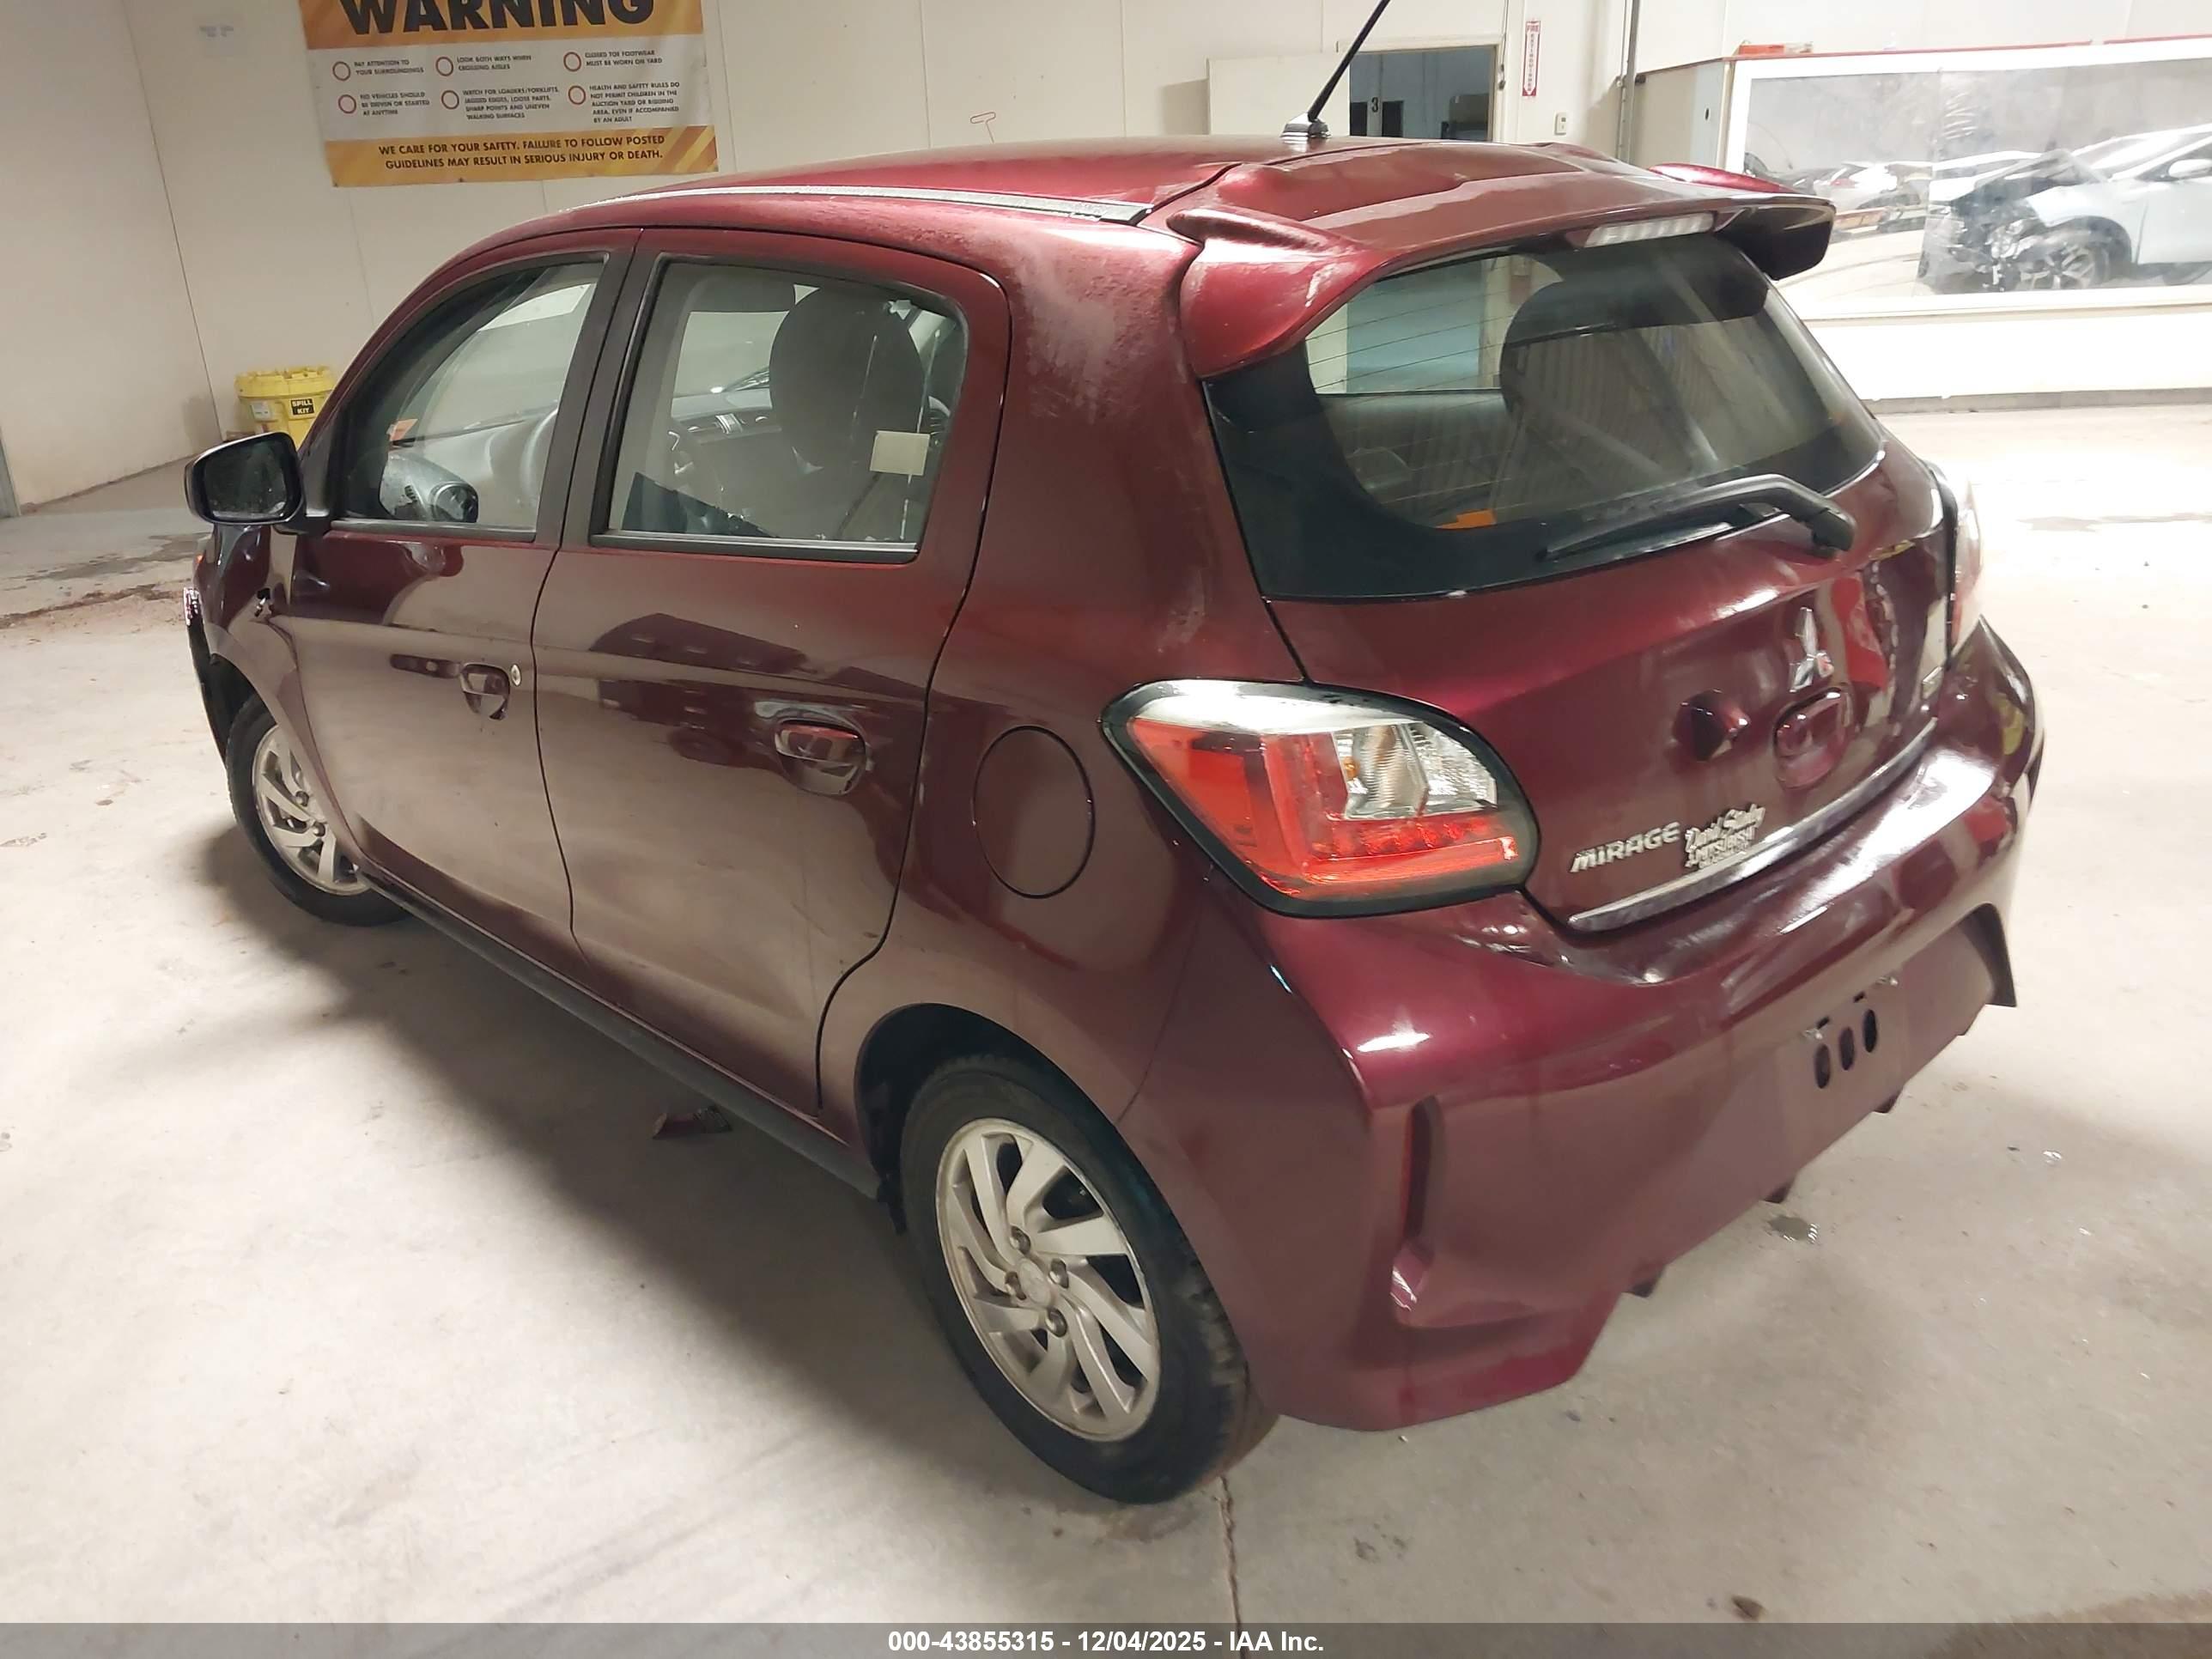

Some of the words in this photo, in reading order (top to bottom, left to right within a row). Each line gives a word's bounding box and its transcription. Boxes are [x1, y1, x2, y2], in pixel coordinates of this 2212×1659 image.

[340, 0, 654, 34] WARNING
[1371, 97, 1378, 112] 3
[379, 145, 396, 155] WE
[399, 144, 425, 154] CARE
[428, 143, 447, 153] FOR
[451, 142, 480, 152] YOUR
[483, 141, 520, 151] SAFETY.
[522, 139, 562, 149] FAILURE
[564, 138, 578, 148] TO
[581, 137, 623, 147] FOLLOW
[626, 135, 665, 145] POSTED
[386, 158, 445, 169] GUIDELINES
[447, 157, 470, 167] MAY
[473, 155, 507, 166] RESULT
[510, 155, 521, 164] IN
[525, 154, 566, 164] SERIOUS
[569, 151, 605, 161] INJURY
[609, 151, 624, 160] OR
[628, 149, 663, 160] DEATH.
[1570, 822, 1680, 872] MIRAGE
